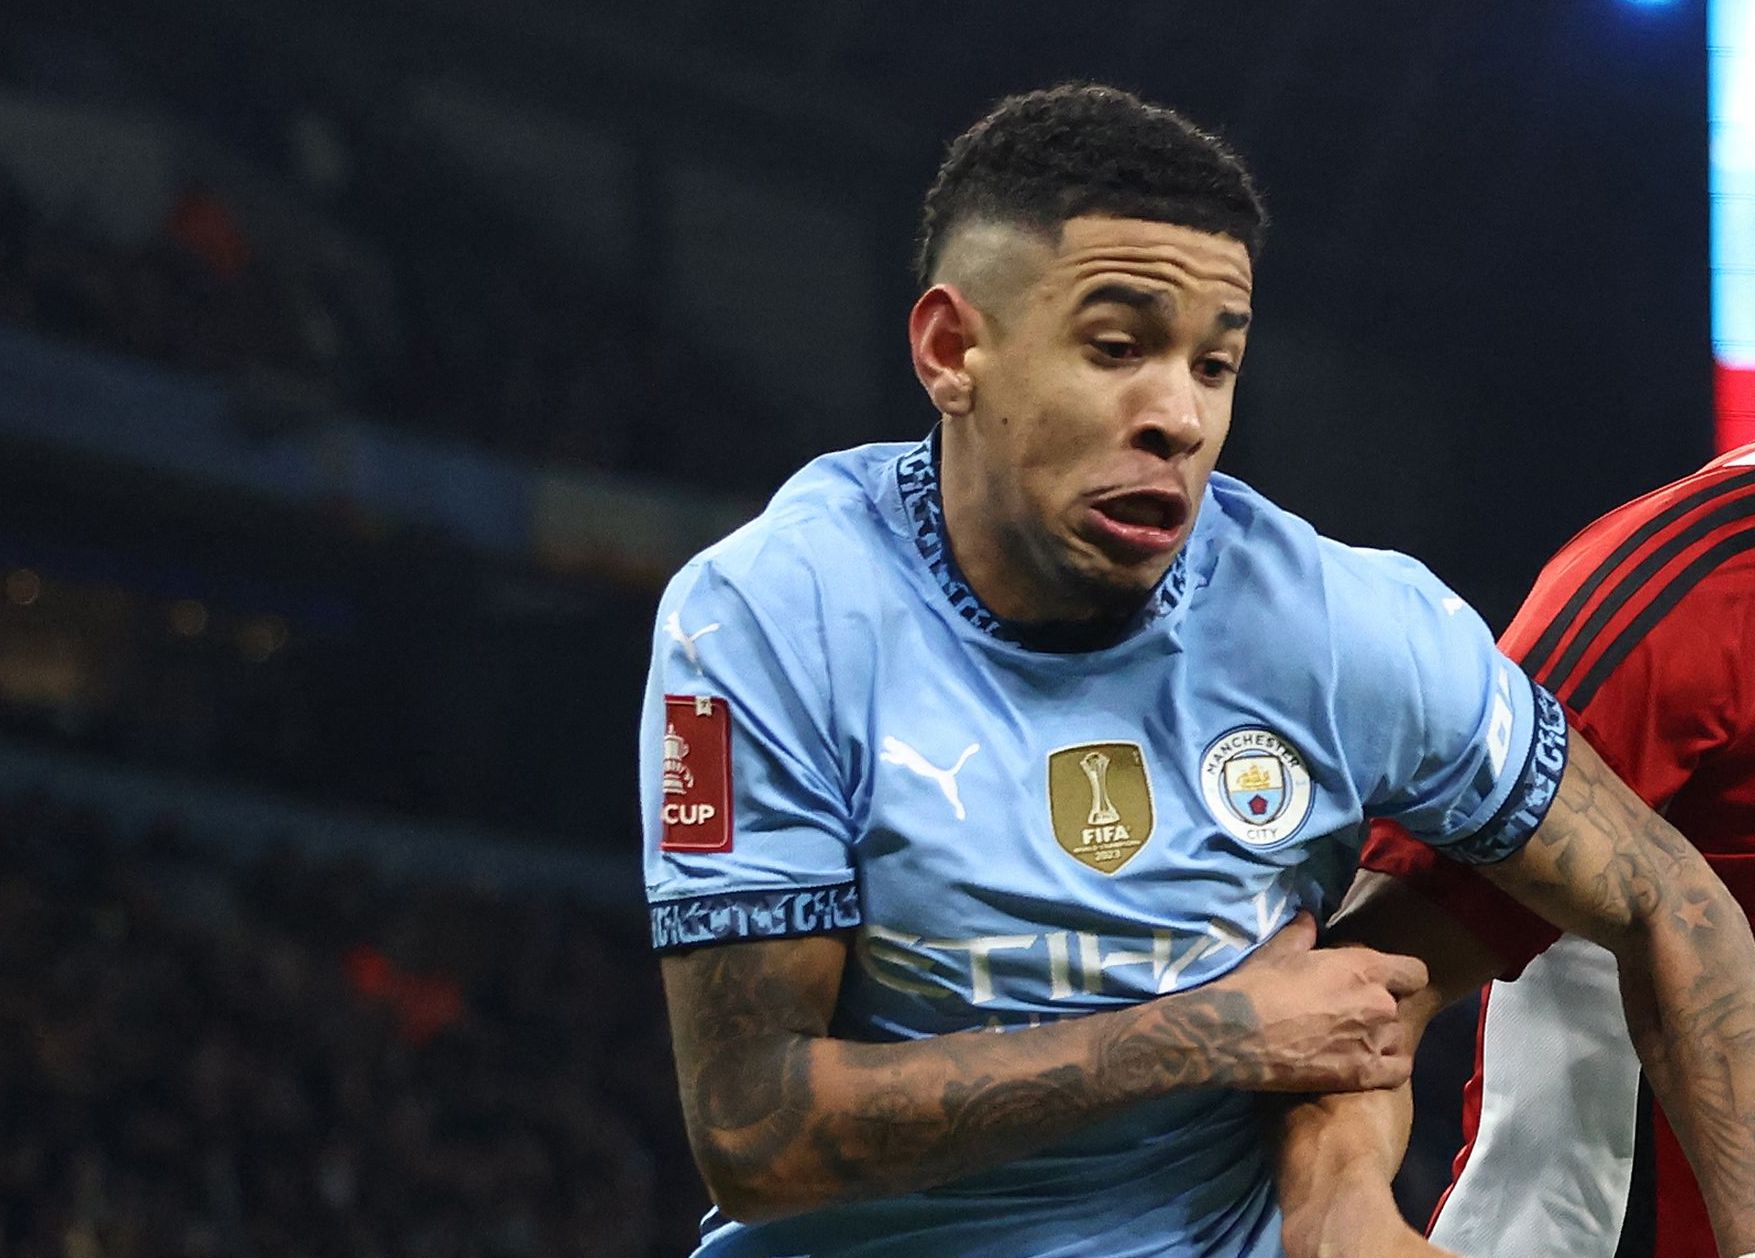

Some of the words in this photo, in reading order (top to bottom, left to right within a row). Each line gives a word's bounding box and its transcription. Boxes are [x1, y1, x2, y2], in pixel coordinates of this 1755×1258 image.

[1207, 735, 1299, 774] MANCHESTER
[662, 803, 715, 825] CUP
[1082, 825, 1129, 845] FIFA
[1247, 828, 1277, 840] CITY
